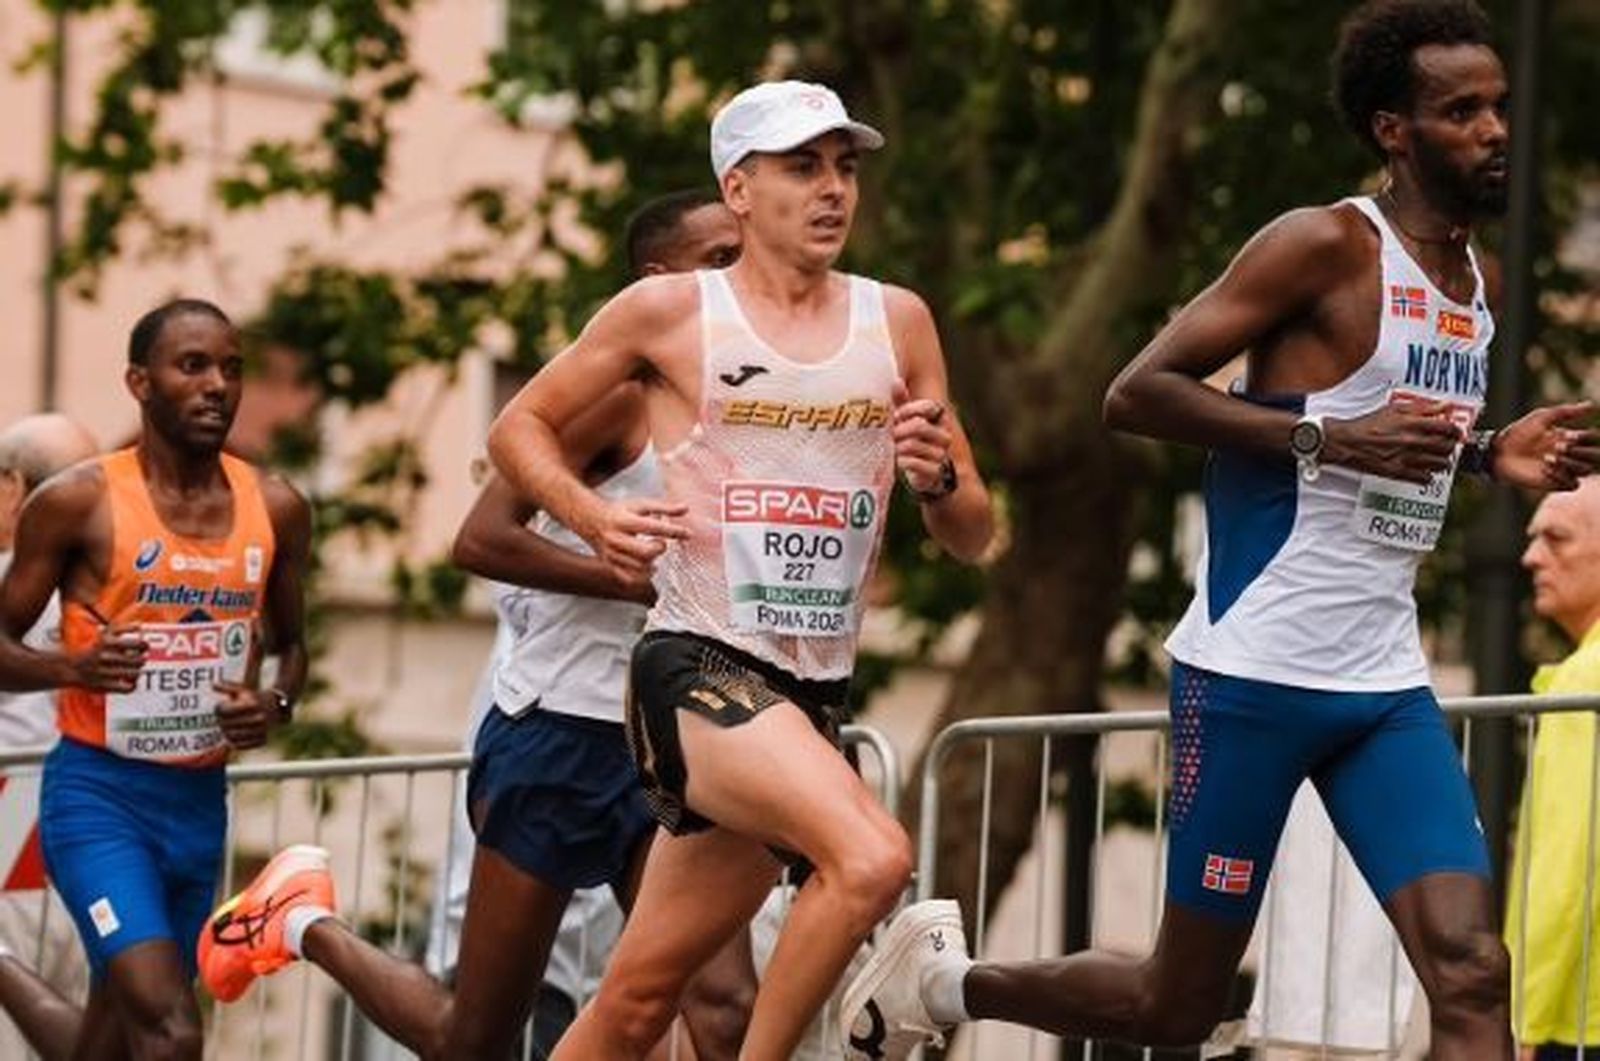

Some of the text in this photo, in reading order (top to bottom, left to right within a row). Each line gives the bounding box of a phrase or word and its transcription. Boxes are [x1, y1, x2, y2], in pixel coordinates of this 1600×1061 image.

[722, 400, 888, 431] ESPAÑA
[729, 489, 846, 523] SPAR
[765, 532, 843, 560] ROJO
[783, 563, 815, 581] 227
[757, 605, 804, 628] ROMA
[127, 736, 189, 753] ROMA
